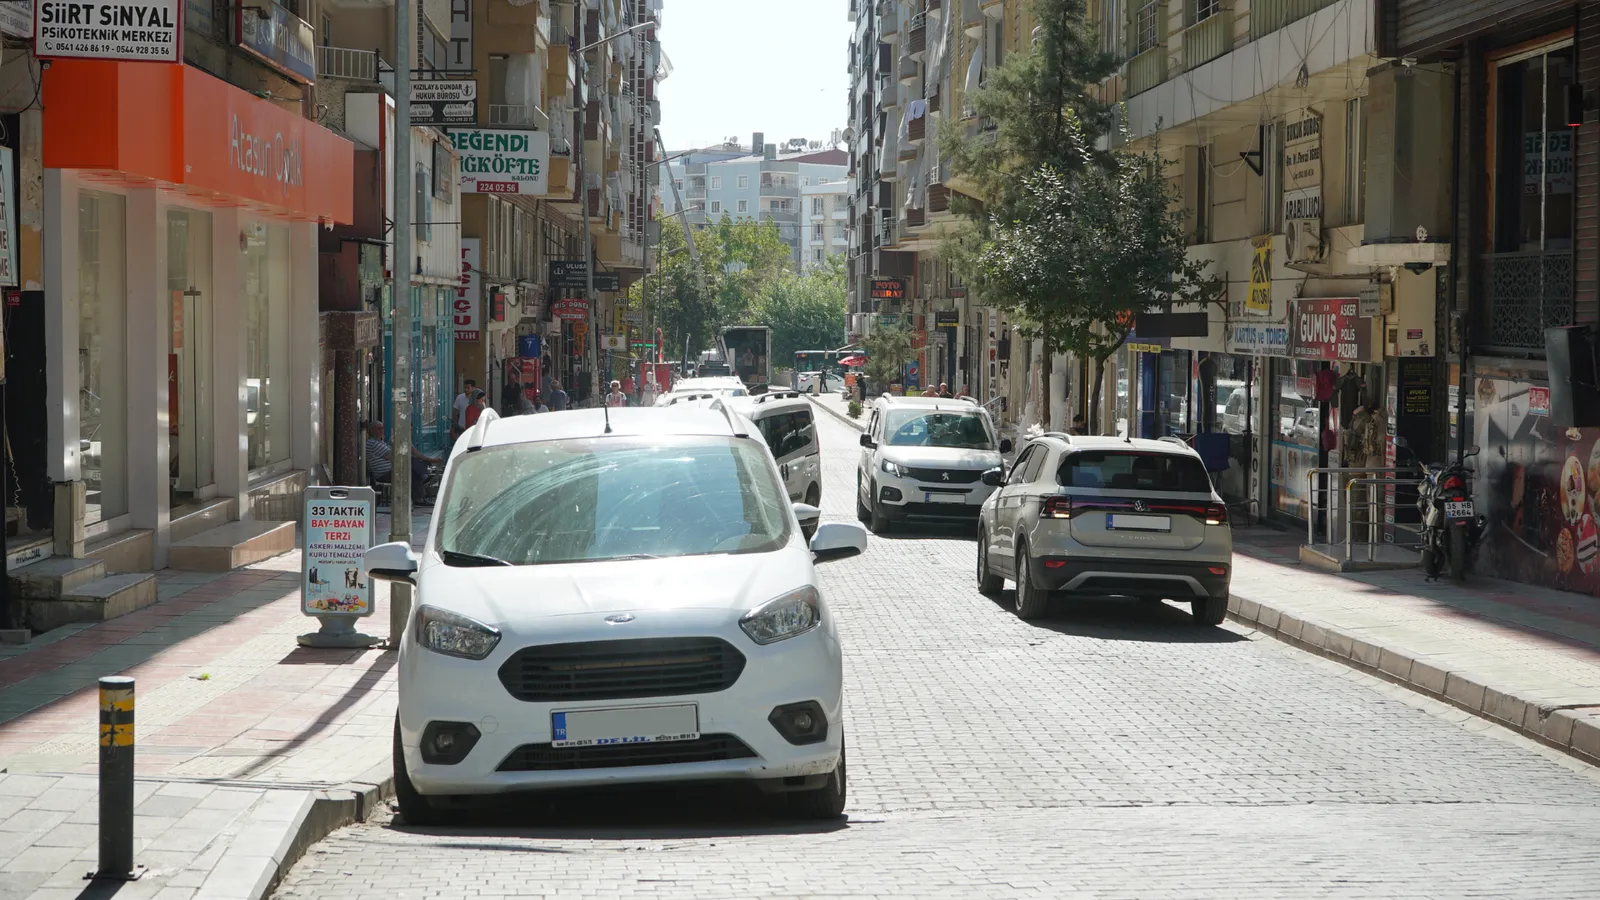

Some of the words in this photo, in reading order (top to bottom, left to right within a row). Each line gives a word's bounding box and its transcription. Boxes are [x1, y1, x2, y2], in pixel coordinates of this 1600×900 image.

[56, 42, 74, 51] 0541
[75, 43, 89, 52] 426
[90, 44, 99, 53] 86
[101, 44, 110, 53] 19
[116, 45, 134, 54] 0544
[136, 45, 149, 55] 928
[150, 46, 159, 55] 35
[160, 46, 170, 55] 56
[415, 92, 436, 100] HUKUK
[230, 113, 272, 179] Atasun
[480, 183, 494, 191] 224
[495, 183, 505, 192] 02
[506, 184, 516, 192] 56
[1301, 304, 1337, 352] GÜMÜŞ
[1341, 304, 1356, 317] ASKER
[1338, 343, 1357, 359] PAZARI
[311, 506, 326, 516] 33
[311, 519, 365, 529] BAY-BAYAN
[556, 728, 566, 736] TR
